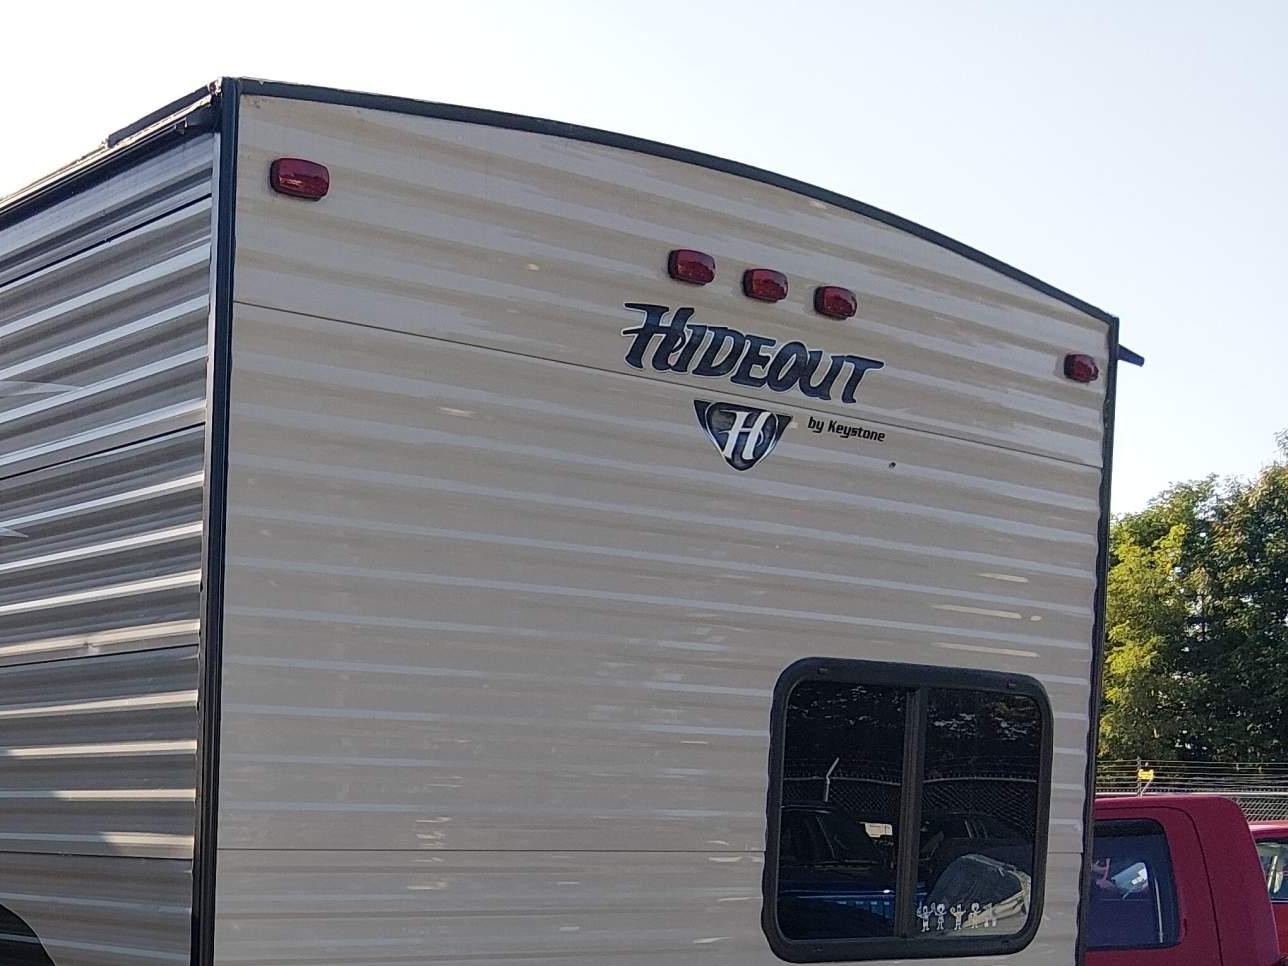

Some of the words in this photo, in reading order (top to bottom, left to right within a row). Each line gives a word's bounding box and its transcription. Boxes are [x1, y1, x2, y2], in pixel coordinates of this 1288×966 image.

[621, 302, 885, 404] HIDEOUT
[808, 416, 824, 434] by
[827, 420, 886, 442] Keystone
